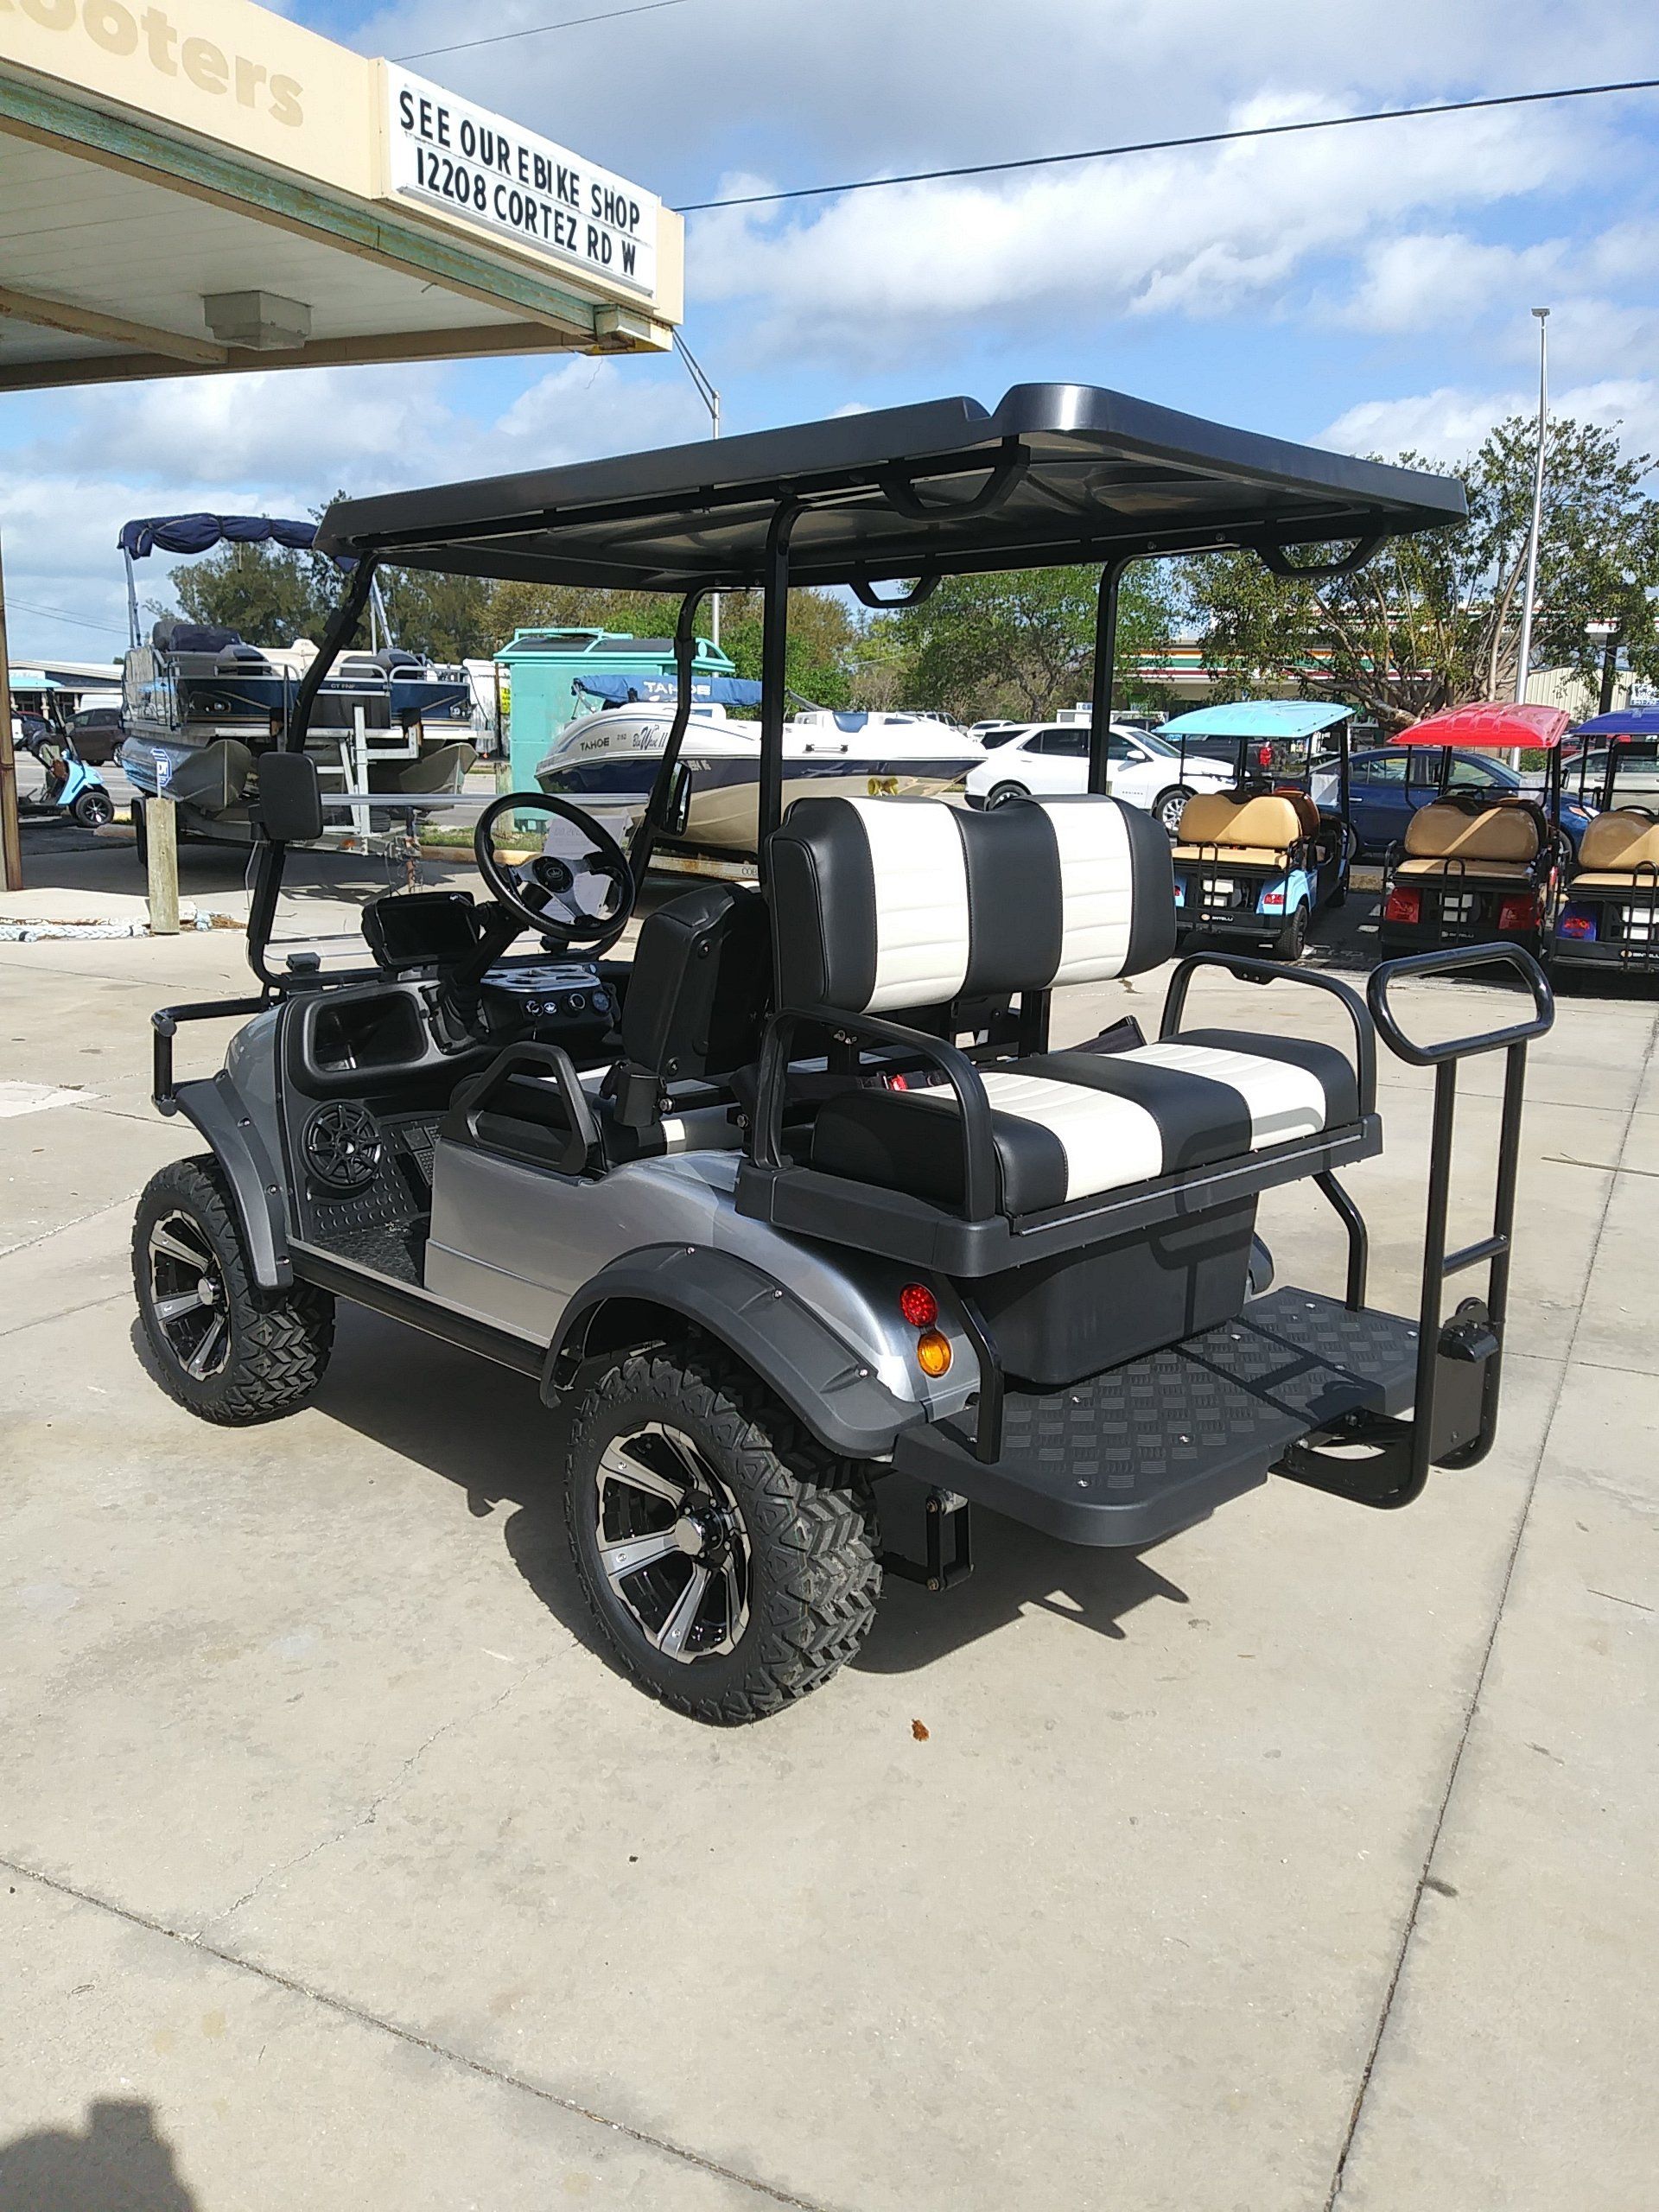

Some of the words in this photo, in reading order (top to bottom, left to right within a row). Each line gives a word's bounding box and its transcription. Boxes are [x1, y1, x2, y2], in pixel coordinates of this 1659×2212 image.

[0, 0, 303, 127] ooters
[399, 90, 450, 149] SEE
[461, 119, 512, 175] OUR
[518, 145, 580, 208] EBIKE
[591, 183, 640, 233] SHOP
[416, 146, 486, 211] 12208
[493, 184, 577, 252] CORTEZ
[587, 223, 613, 264] RD
[621, 239, 636, 276] W
[580, 737, 610, 752] TAHOE
